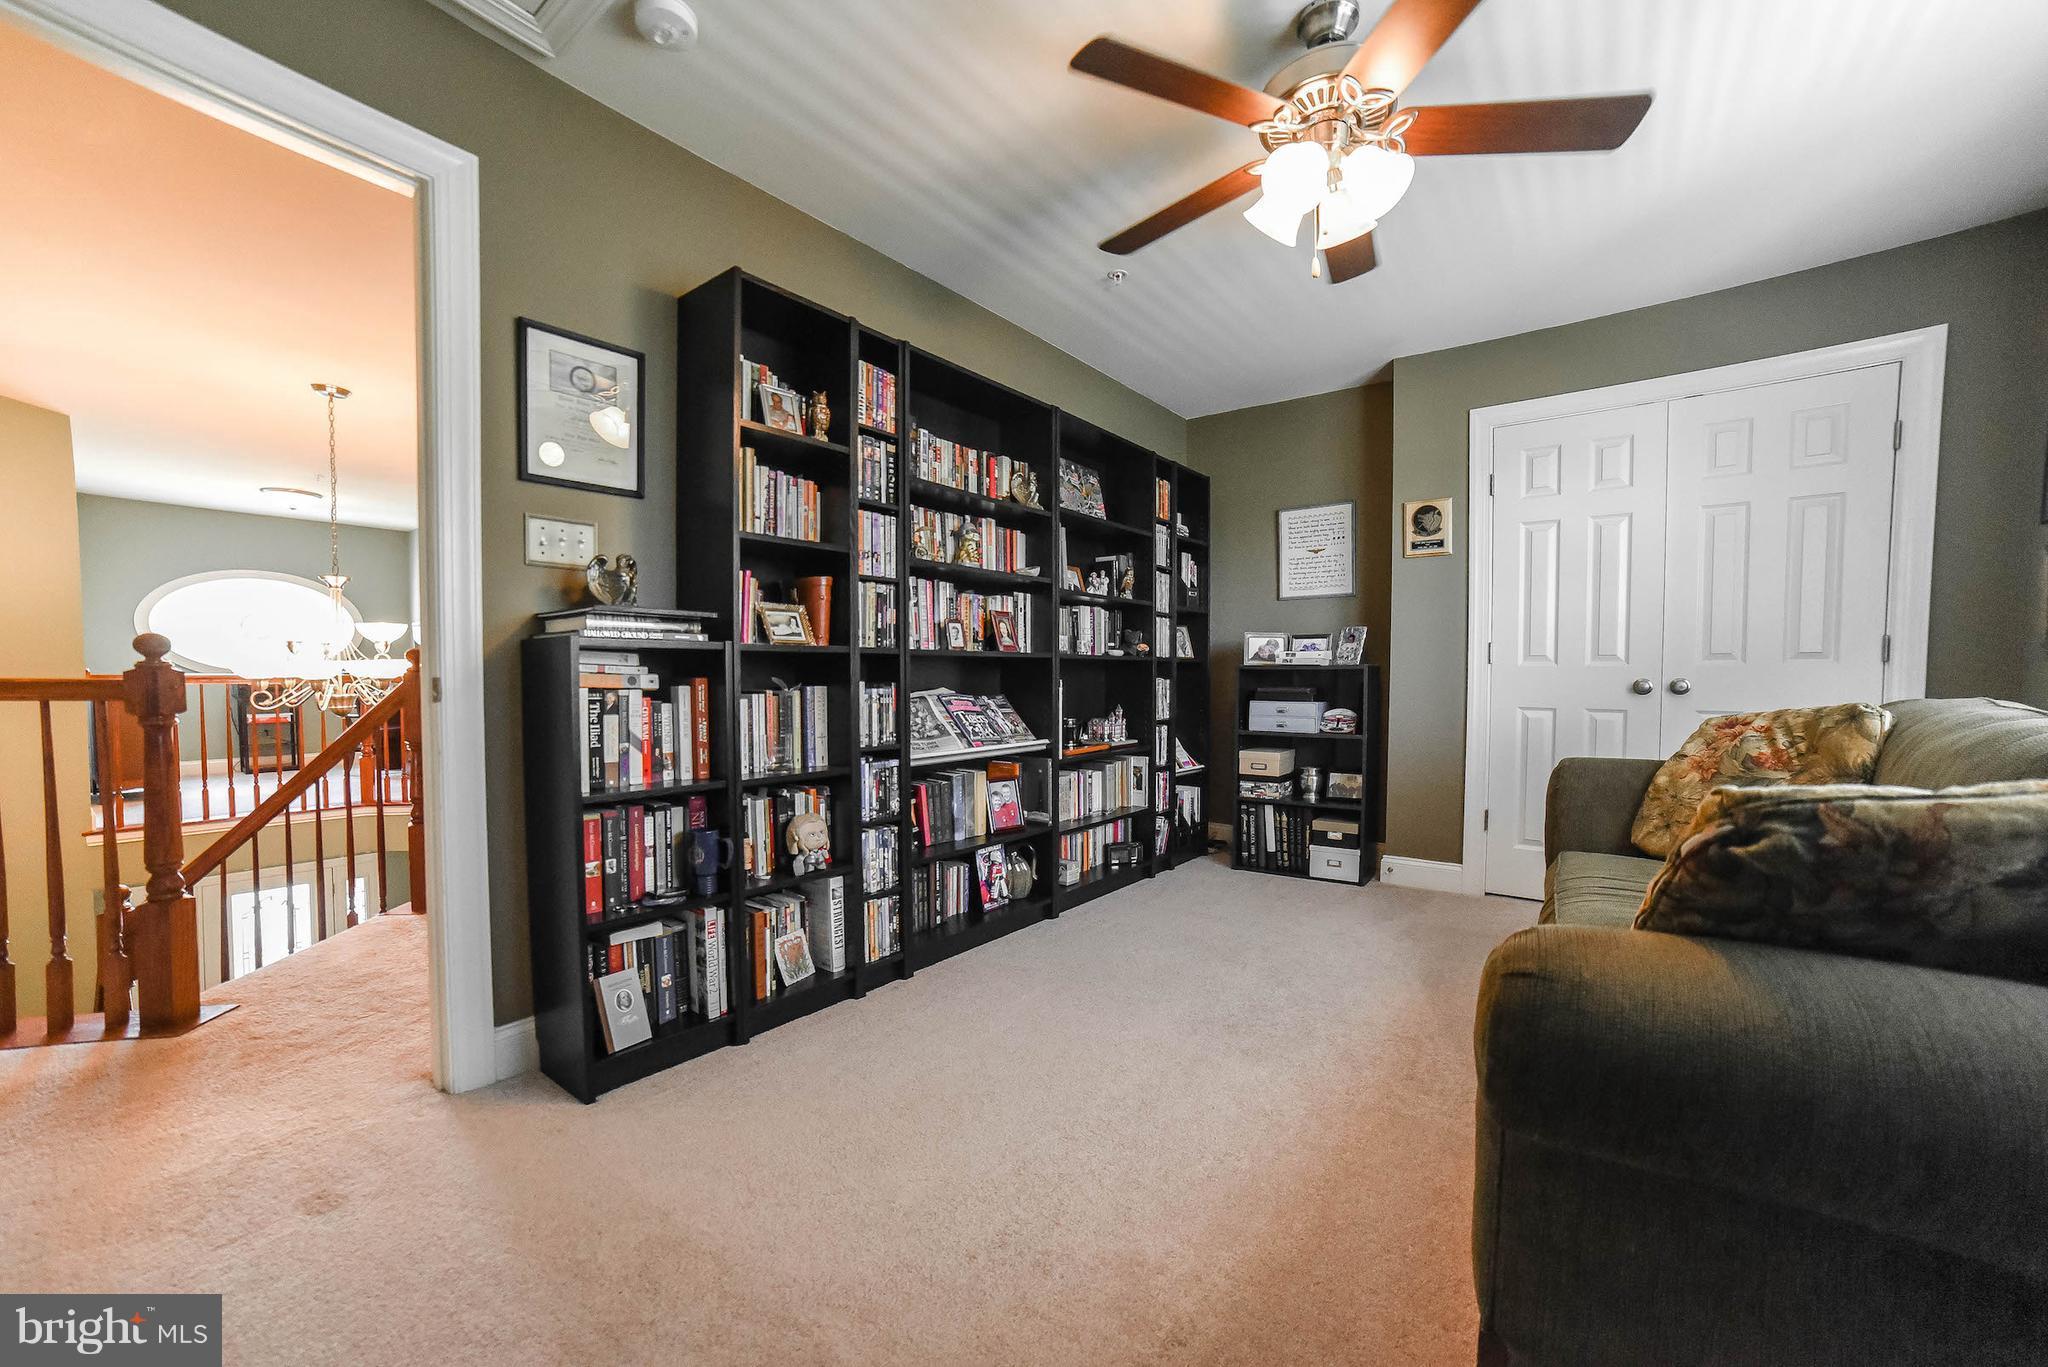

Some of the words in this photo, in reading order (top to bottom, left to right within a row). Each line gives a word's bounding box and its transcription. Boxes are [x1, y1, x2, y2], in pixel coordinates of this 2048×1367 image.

[584, 629, 620, 638] HALLOWED
[620, 631, 648, 639] GROUND
[590, 702, 601, 722] The
[590, 723, 601, 748] Iliad
[707, 920, 716, 939] LIFE
[832, 899, 844, 950] STRONGEST
[708, 940, 717, 968] World
[709, 968, 718, 987] War
